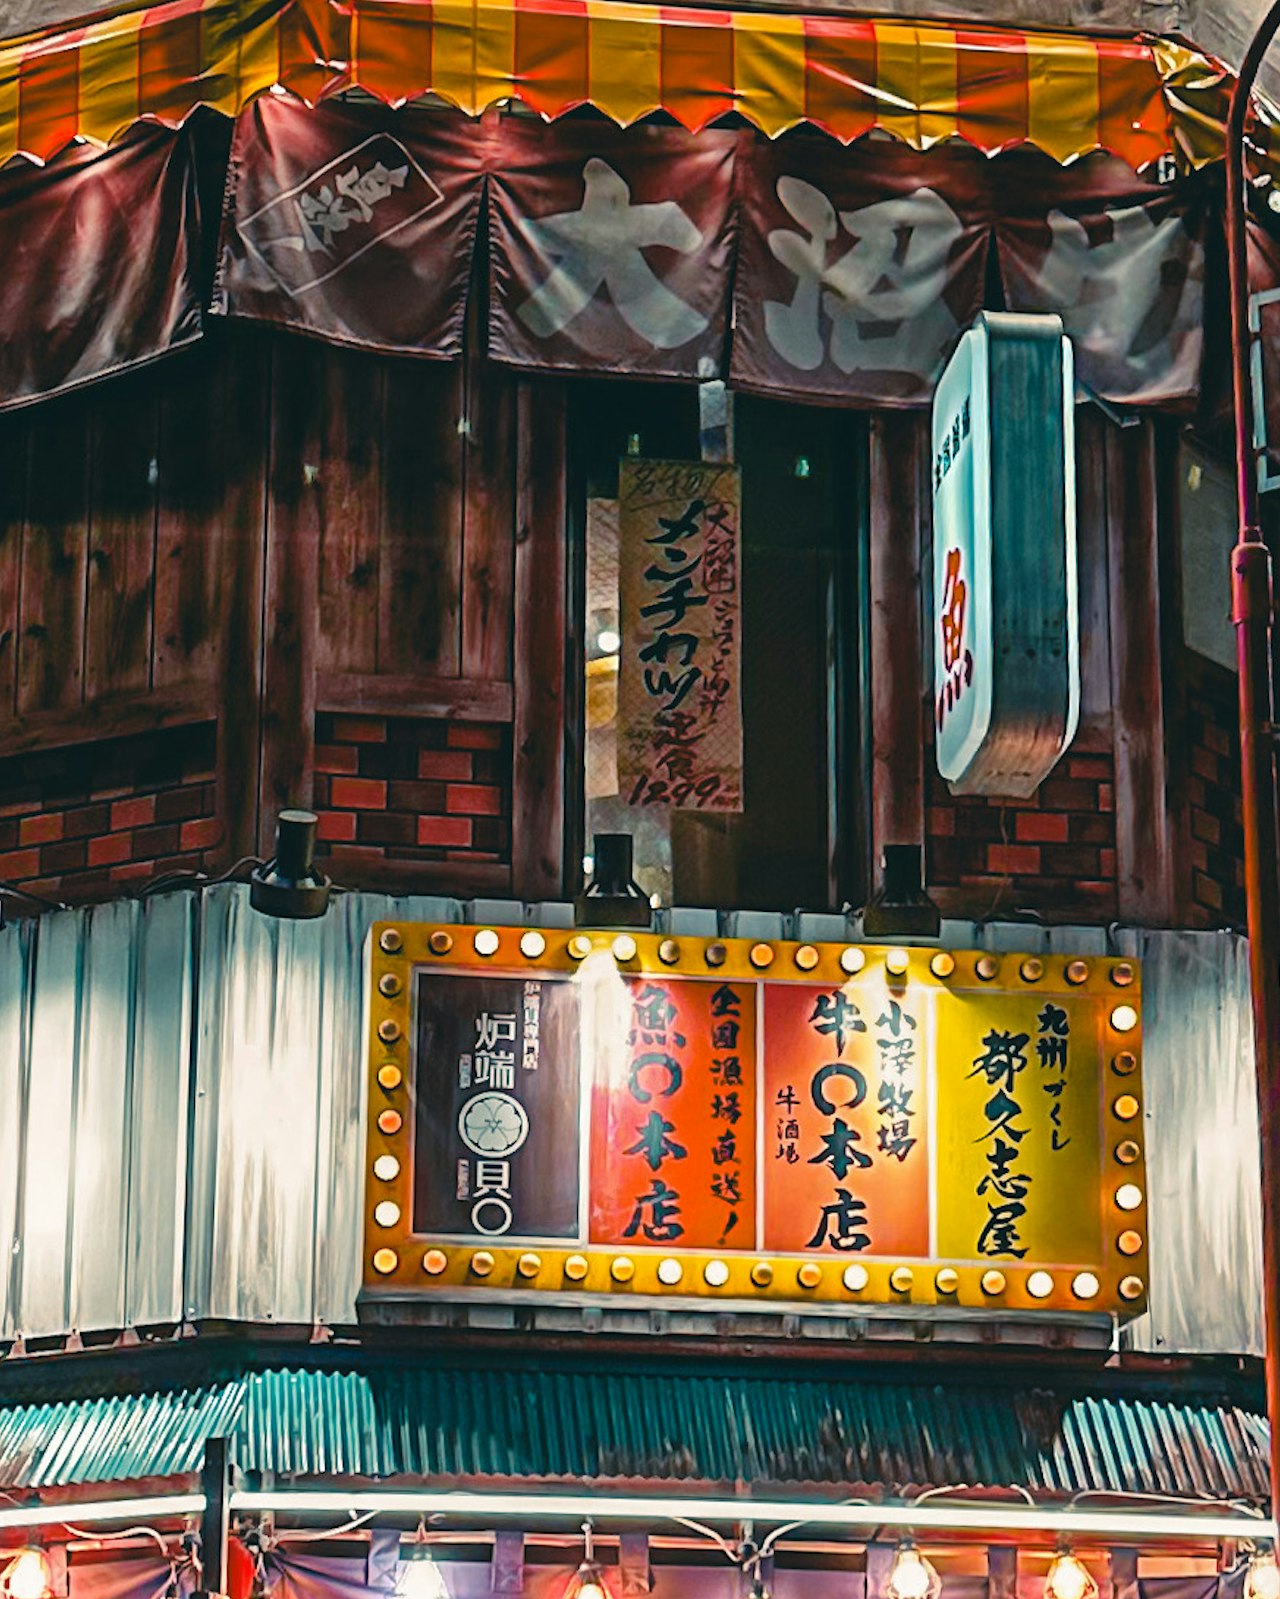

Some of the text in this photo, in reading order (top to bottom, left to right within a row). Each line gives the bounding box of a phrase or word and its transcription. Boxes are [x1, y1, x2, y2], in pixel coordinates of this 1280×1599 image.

[474, 1012, 518, 1090] 炉端
[773, 1085, 803, 1165] 牛酒場
[965, 1029, 1034, 1259] 都久志屋
